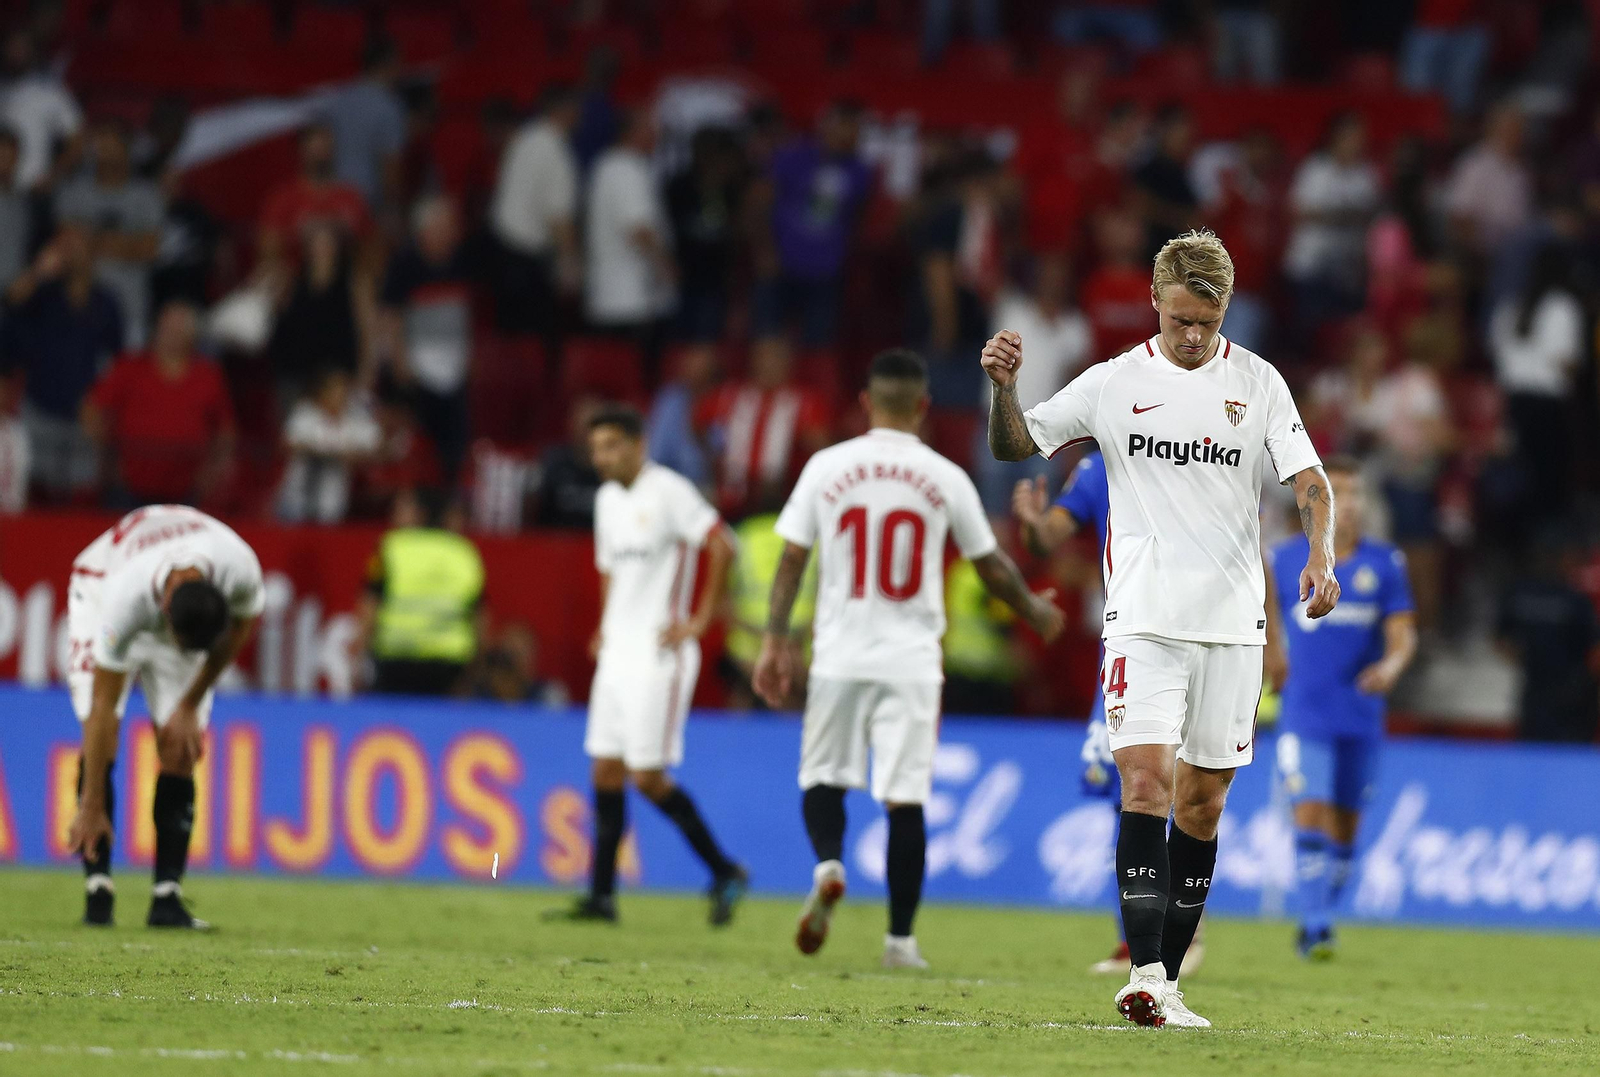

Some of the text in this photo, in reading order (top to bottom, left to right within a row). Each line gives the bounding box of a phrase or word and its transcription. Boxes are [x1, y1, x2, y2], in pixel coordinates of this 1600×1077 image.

[1128, 433, 1242, 467] Playtika
[838, 504, 926, 603] 10
[1106, 656, 1128, 699] 4
[1126, 866, 1157, 879] SFC
[1184, 877, 1210, 888] SFC
